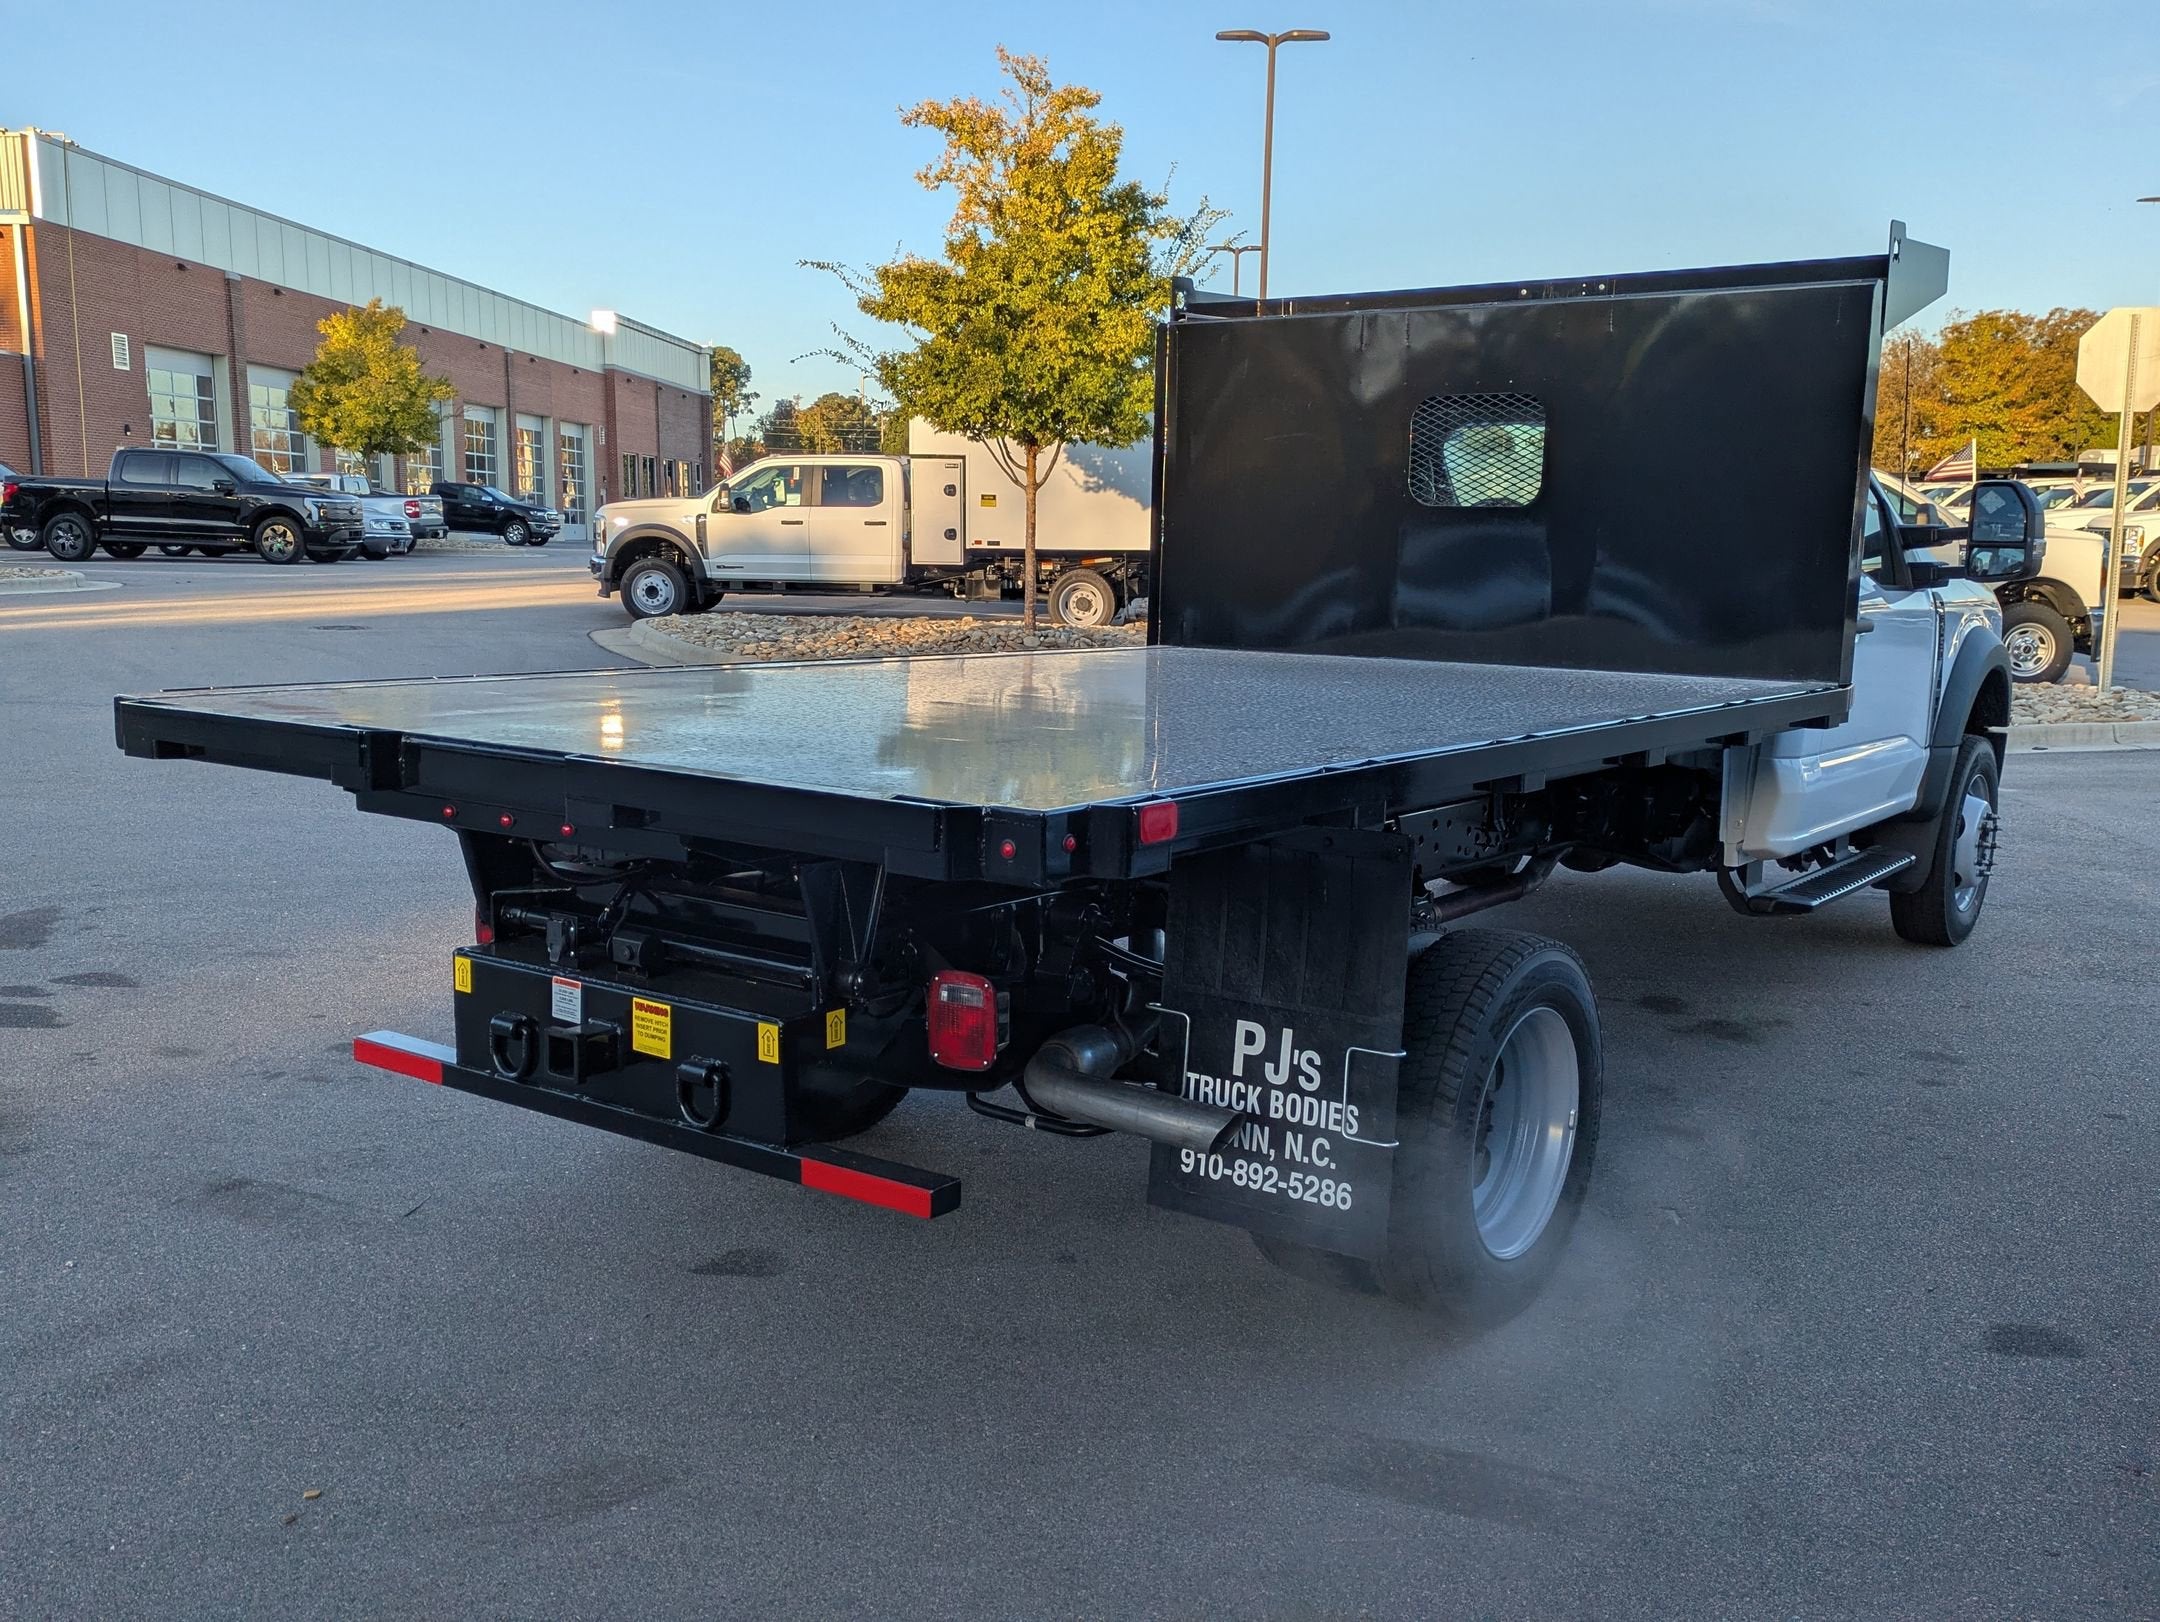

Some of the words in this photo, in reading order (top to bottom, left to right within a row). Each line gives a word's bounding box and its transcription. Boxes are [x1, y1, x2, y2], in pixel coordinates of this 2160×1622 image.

[635, 1015, 654, 1025] REMOVE
[654, 1020, 669, 1029] HITCH
[1187, 1072, 1261, 1115] TRUCK
[1269, 1089, 1359, 1135] BODIES
[1233, 1122, 1276, 1161] NN,
[1284, 1132, 1336, 1170] N.C.
[1180, 1149, 1353, 1211] 910-892-5286
